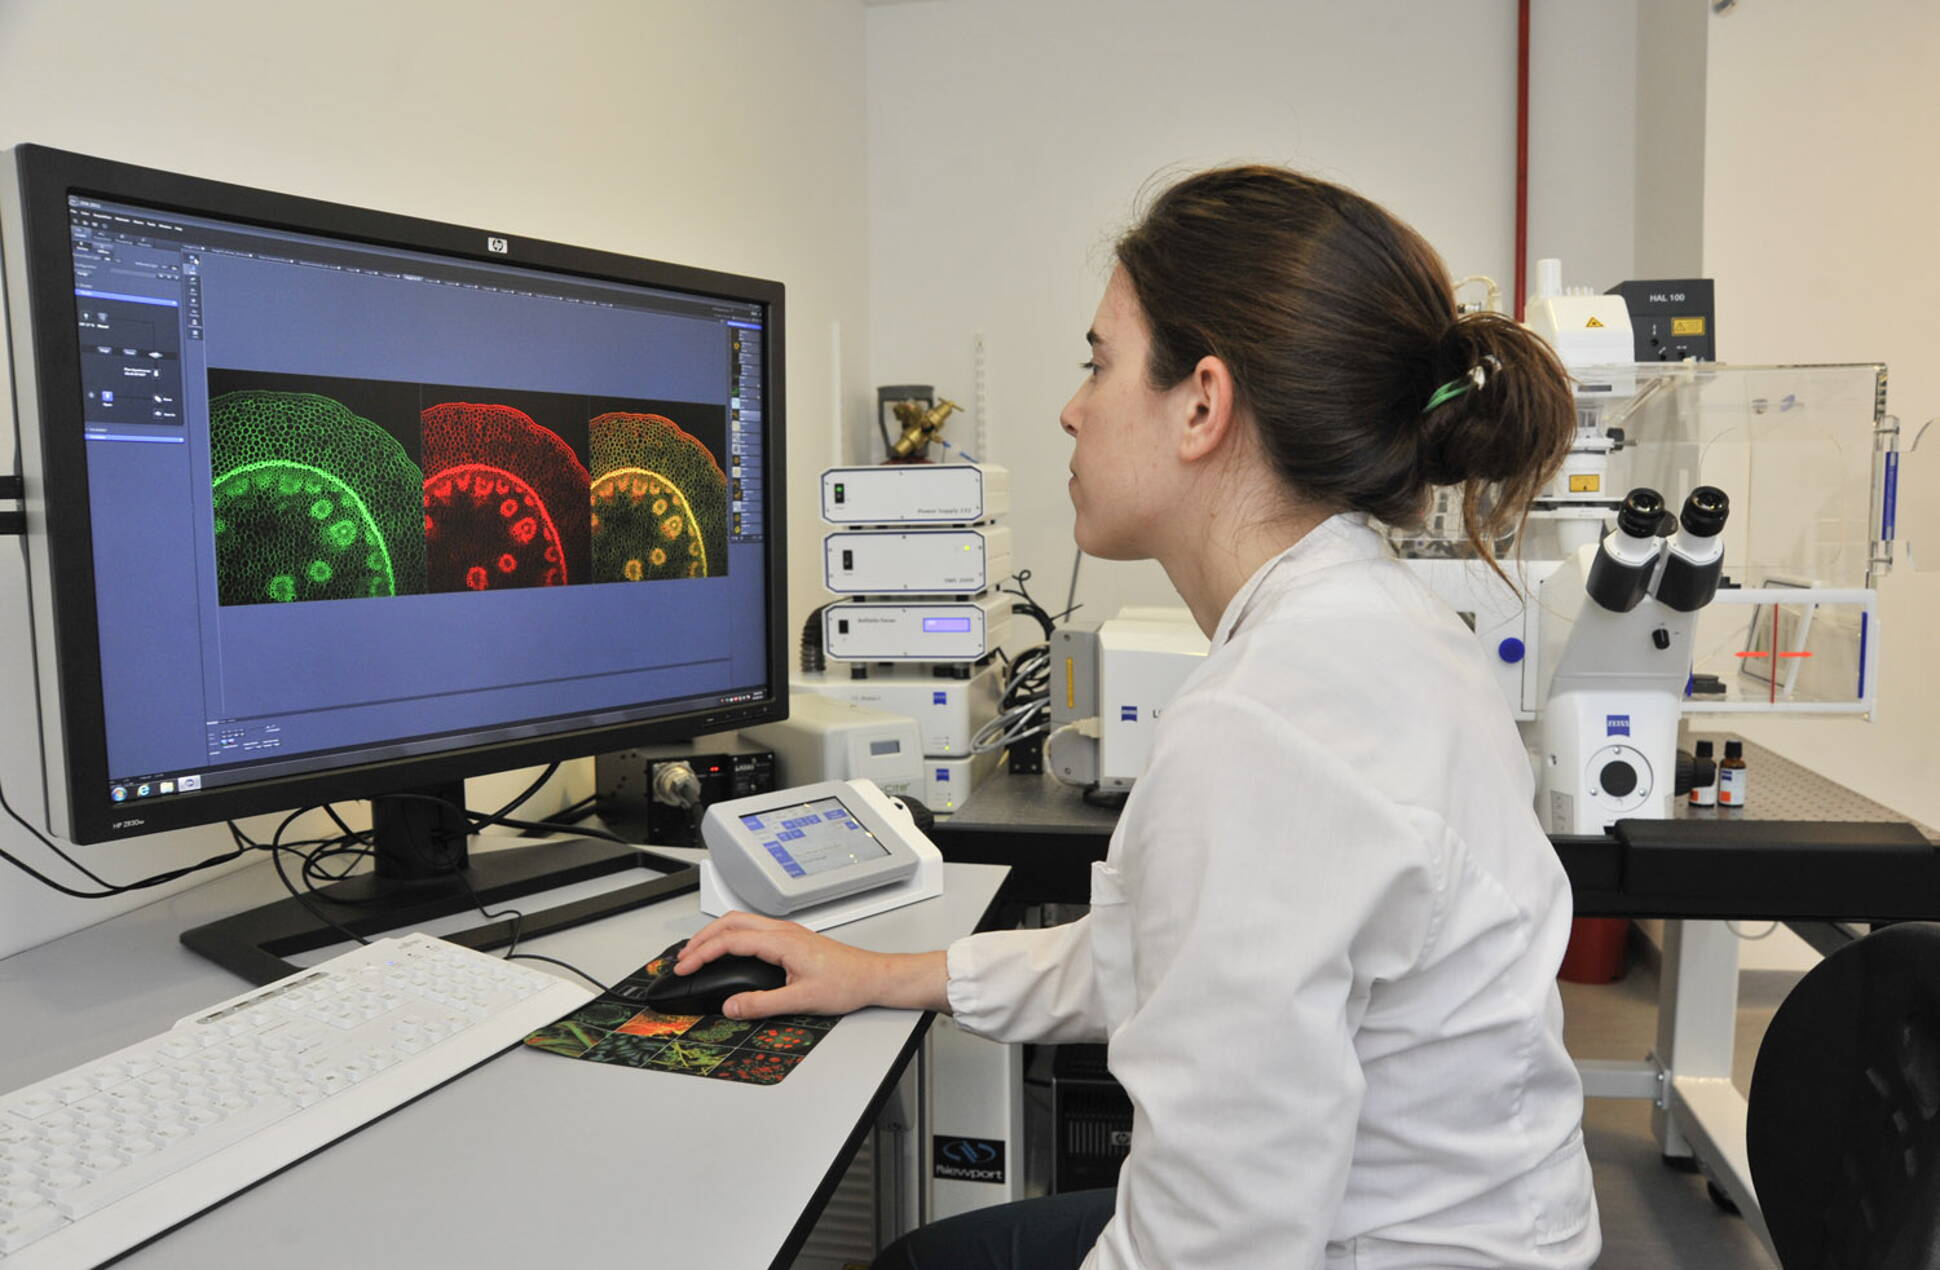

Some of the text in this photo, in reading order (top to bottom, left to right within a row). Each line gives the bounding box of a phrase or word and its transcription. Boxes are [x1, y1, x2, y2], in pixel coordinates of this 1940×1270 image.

[1649, 292, 1685, 303] HAL 100
[1608, 719, 1630, 728] ZEISS
[935, 1163, 1003, 1181] Newport
